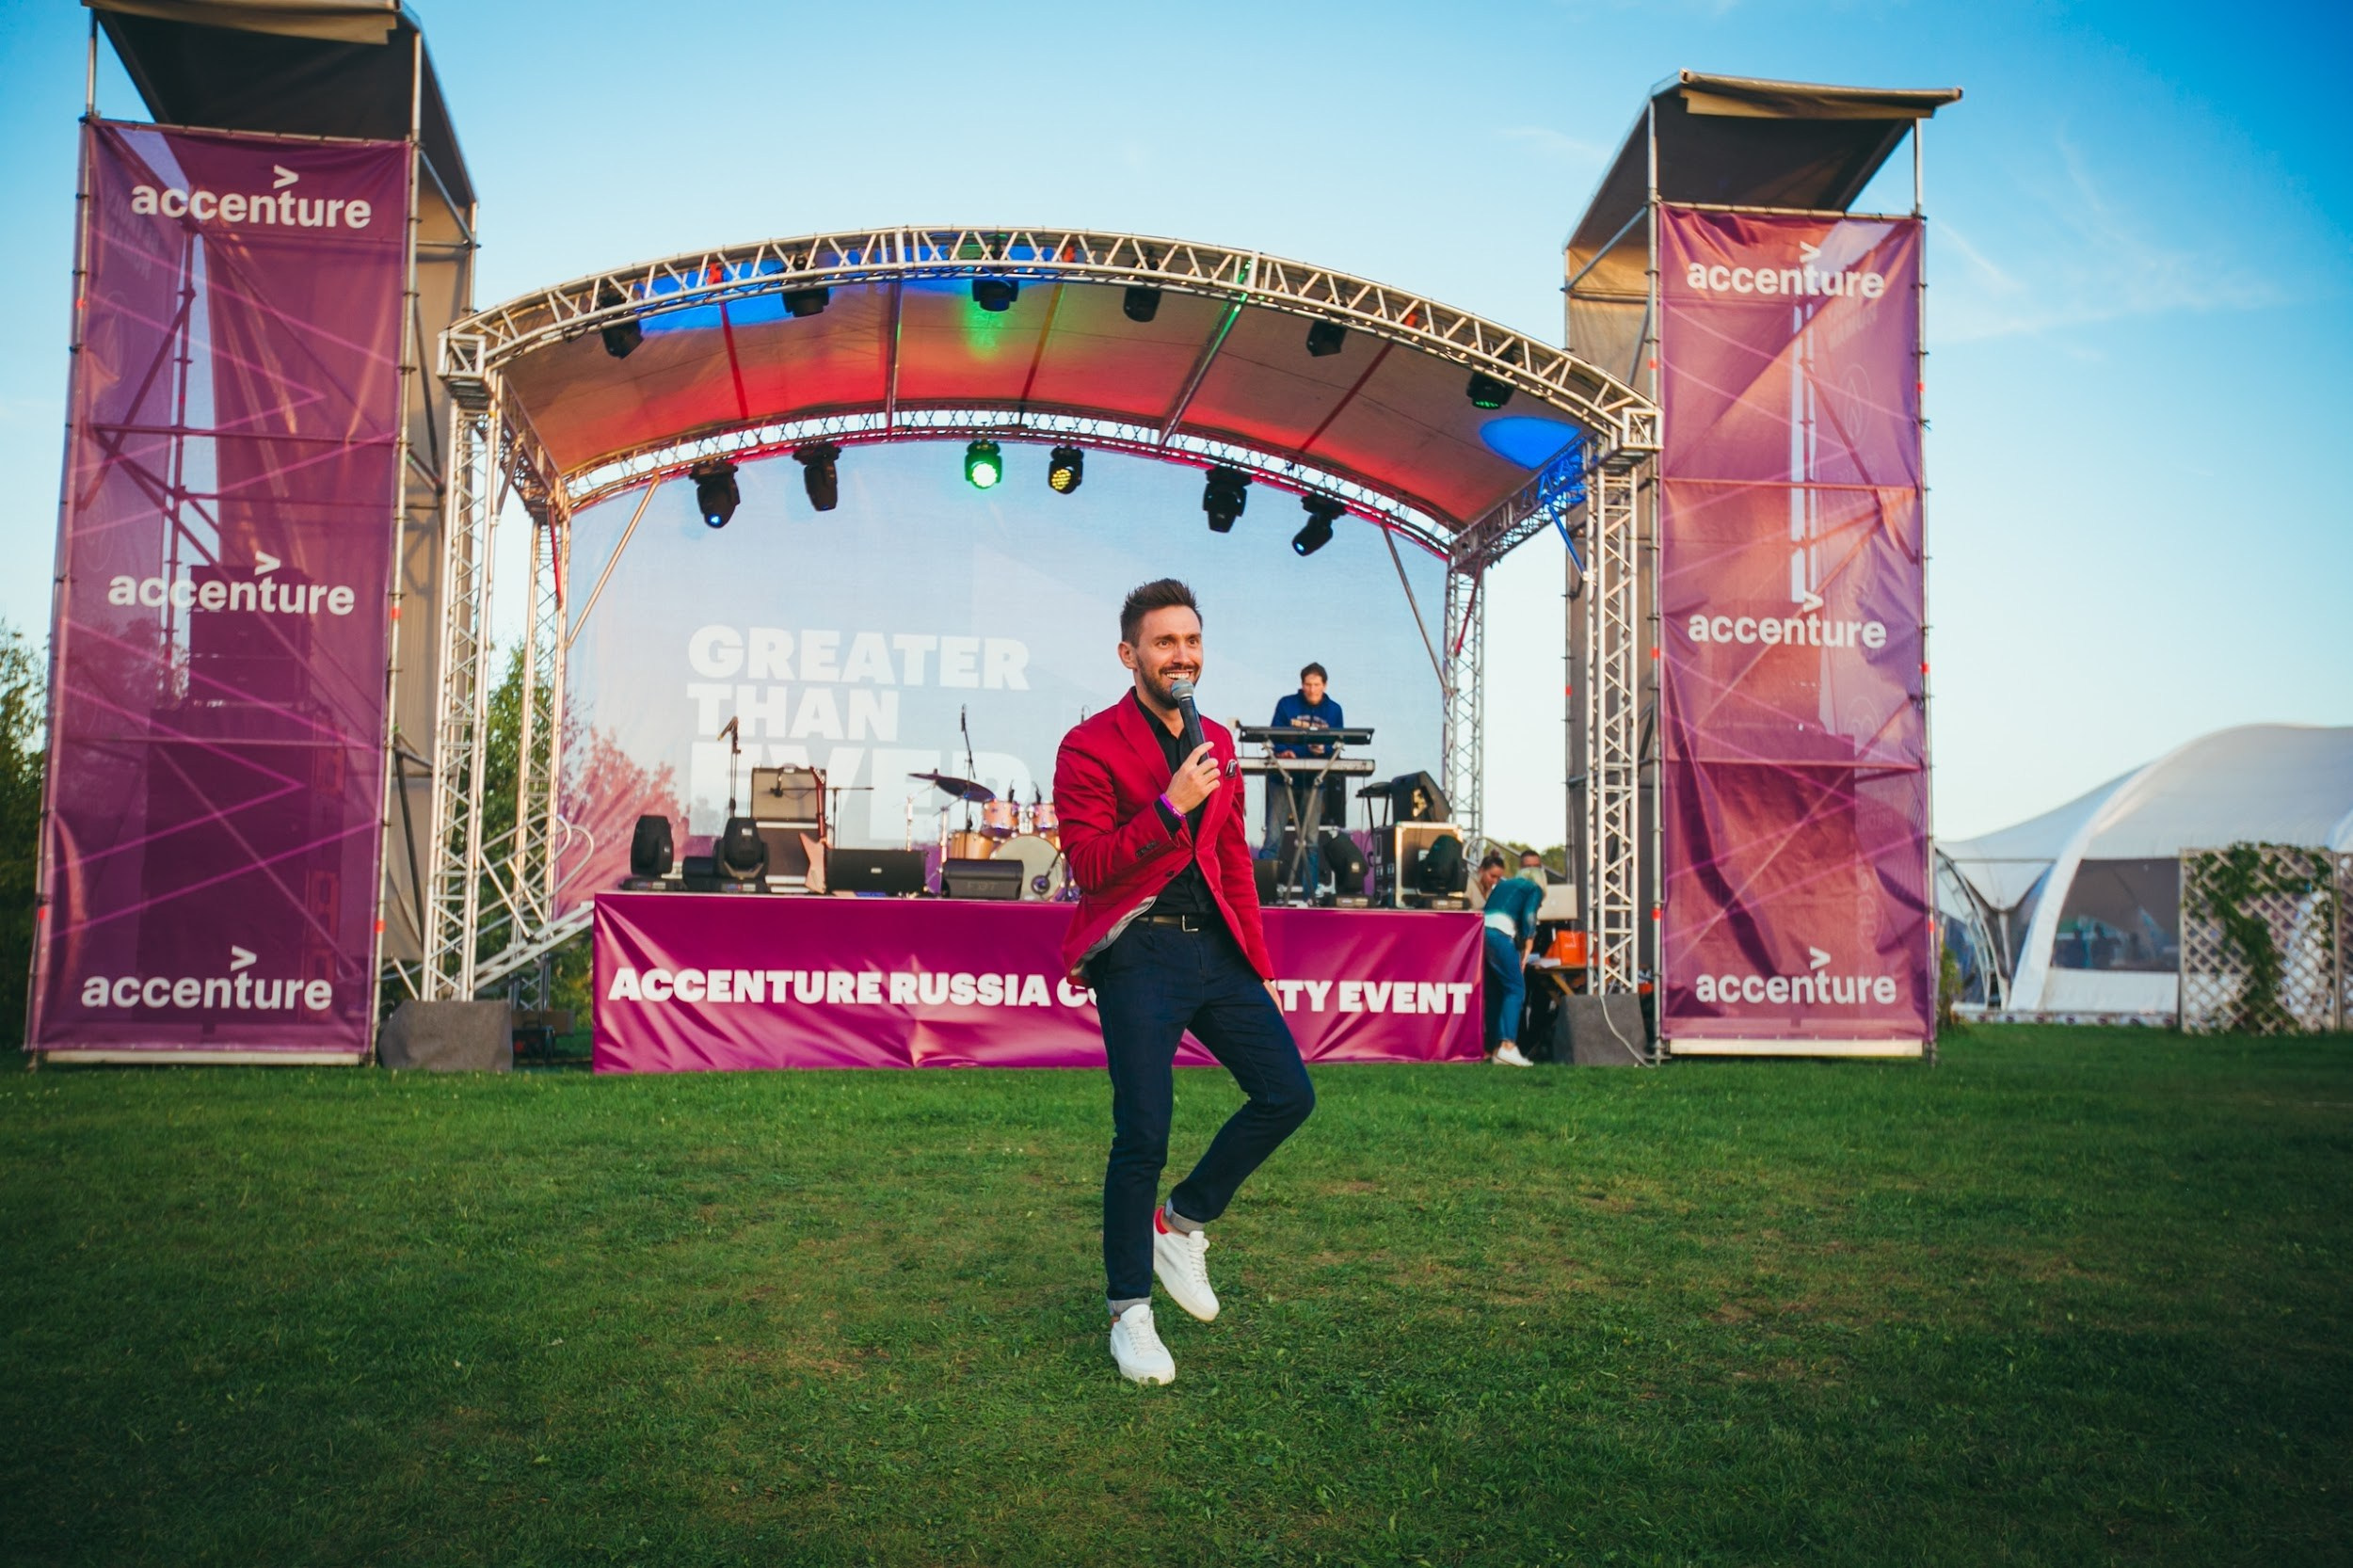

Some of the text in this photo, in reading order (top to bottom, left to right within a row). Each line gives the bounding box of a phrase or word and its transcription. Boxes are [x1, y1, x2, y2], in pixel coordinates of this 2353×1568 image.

[132, 185, 371, 229] accenture
[1687, 263, 1884, 298] accenture
[108, 575, 355, 616] accenture
[1689, 613, 1886, 648] accenture
[688, 625, 1030, 691] GREATER
[687, 682, 899, 742] THAN
[82, 971, 332, 1011] accenture
[608, 968, 883, 1004] ACCENTURE
[889, 972, 1051, 1007] RUSSIA
[1338, 980, 1473, 1014] EVENT
[1696, 969, 1897, 1004] accenture
